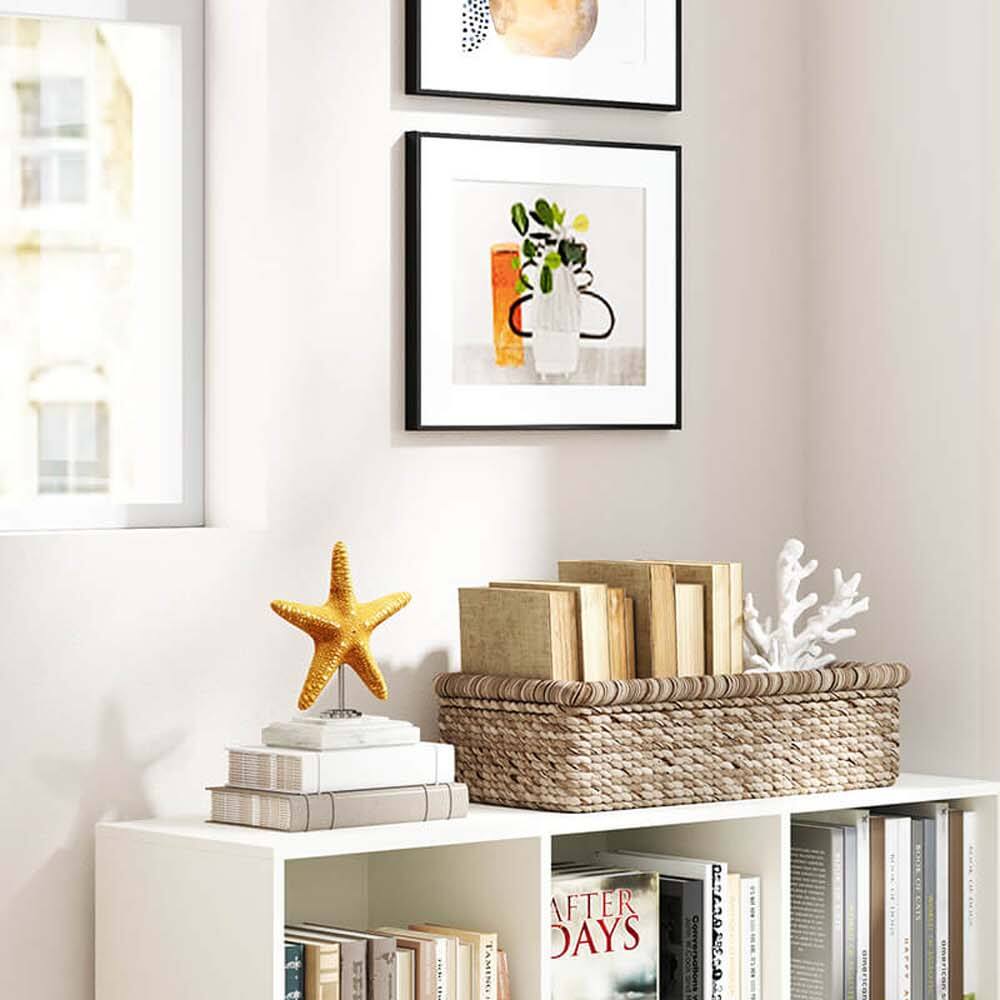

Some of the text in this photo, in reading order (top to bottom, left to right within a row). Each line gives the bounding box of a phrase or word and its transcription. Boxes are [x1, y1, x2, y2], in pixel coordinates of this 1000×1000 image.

[551, 888, 635, 921] AFTER
[551, 915, 640, 959] DAYS
[485, 941, 493, 993] TAMING
